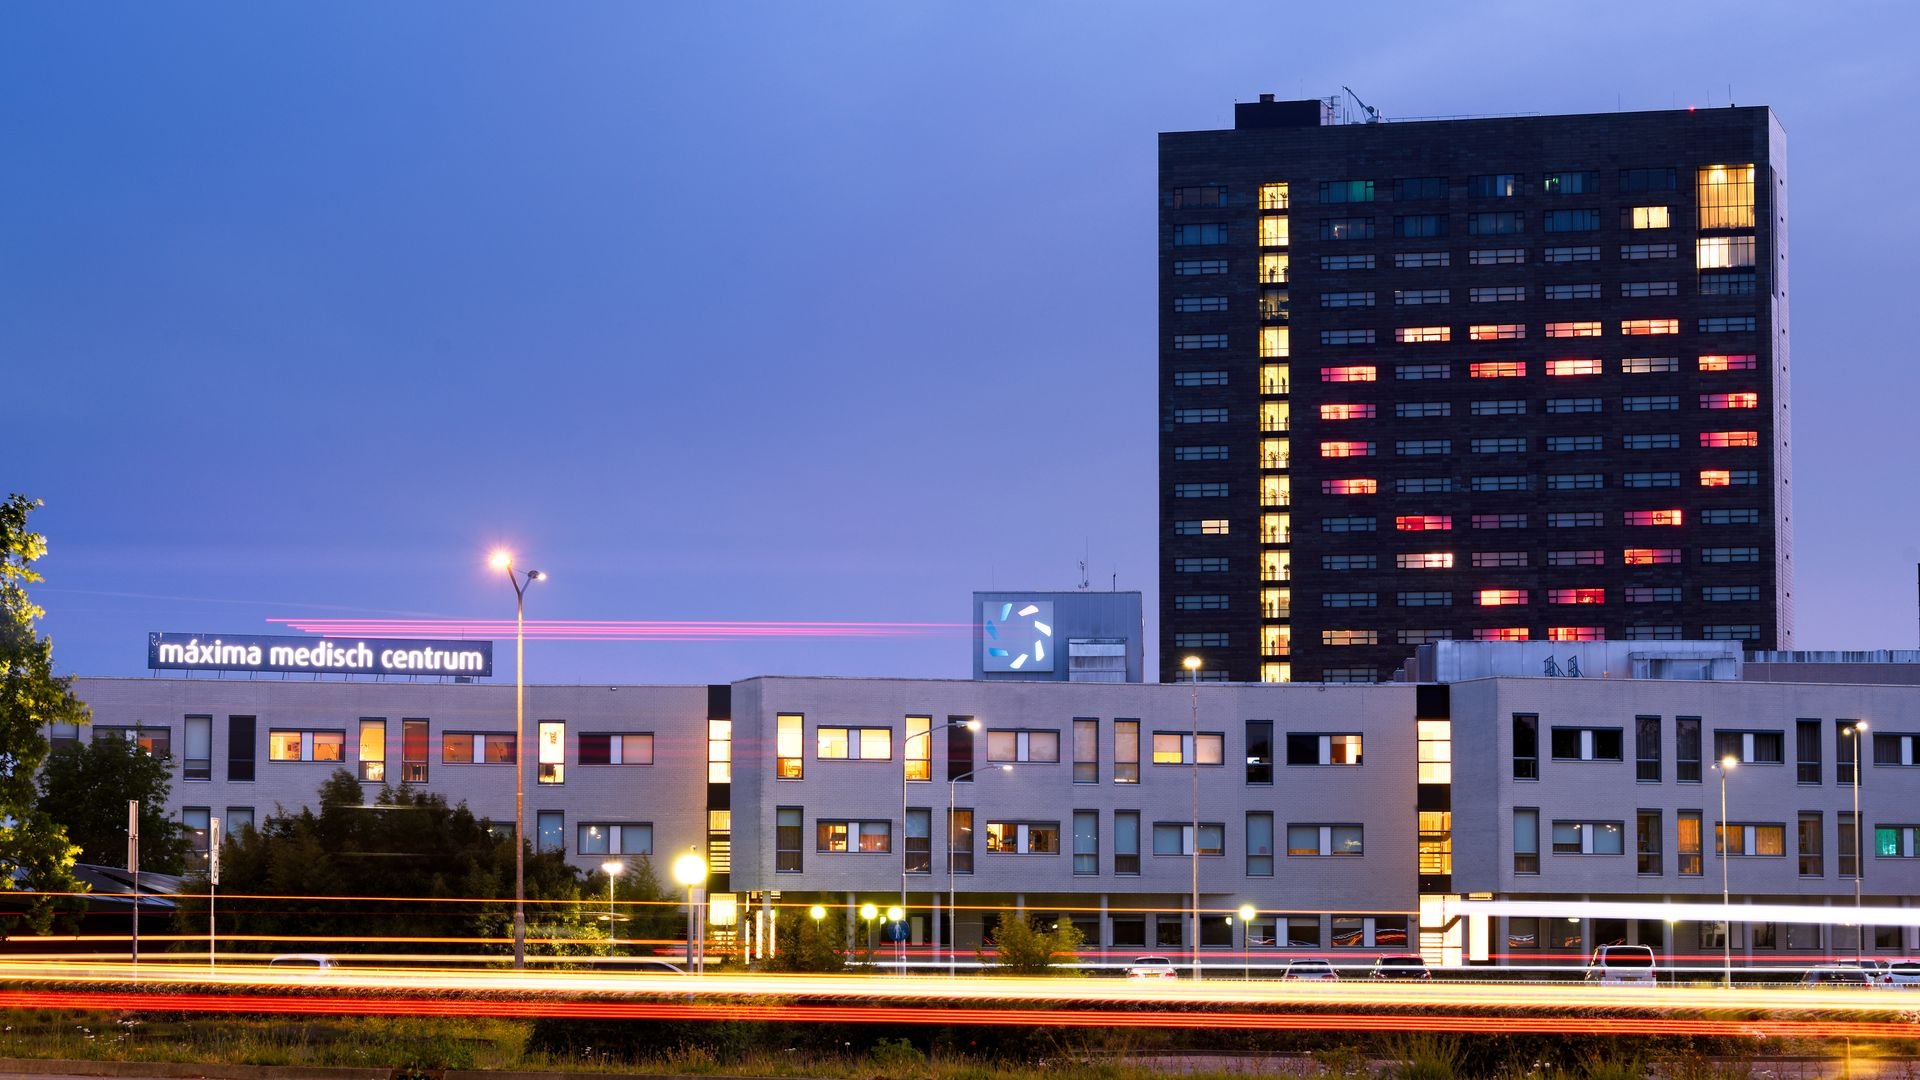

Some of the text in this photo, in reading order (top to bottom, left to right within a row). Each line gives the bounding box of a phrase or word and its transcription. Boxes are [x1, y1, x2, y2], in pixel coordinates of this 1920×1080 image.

[159, 639, 483, 670] máxima medisch centrum
